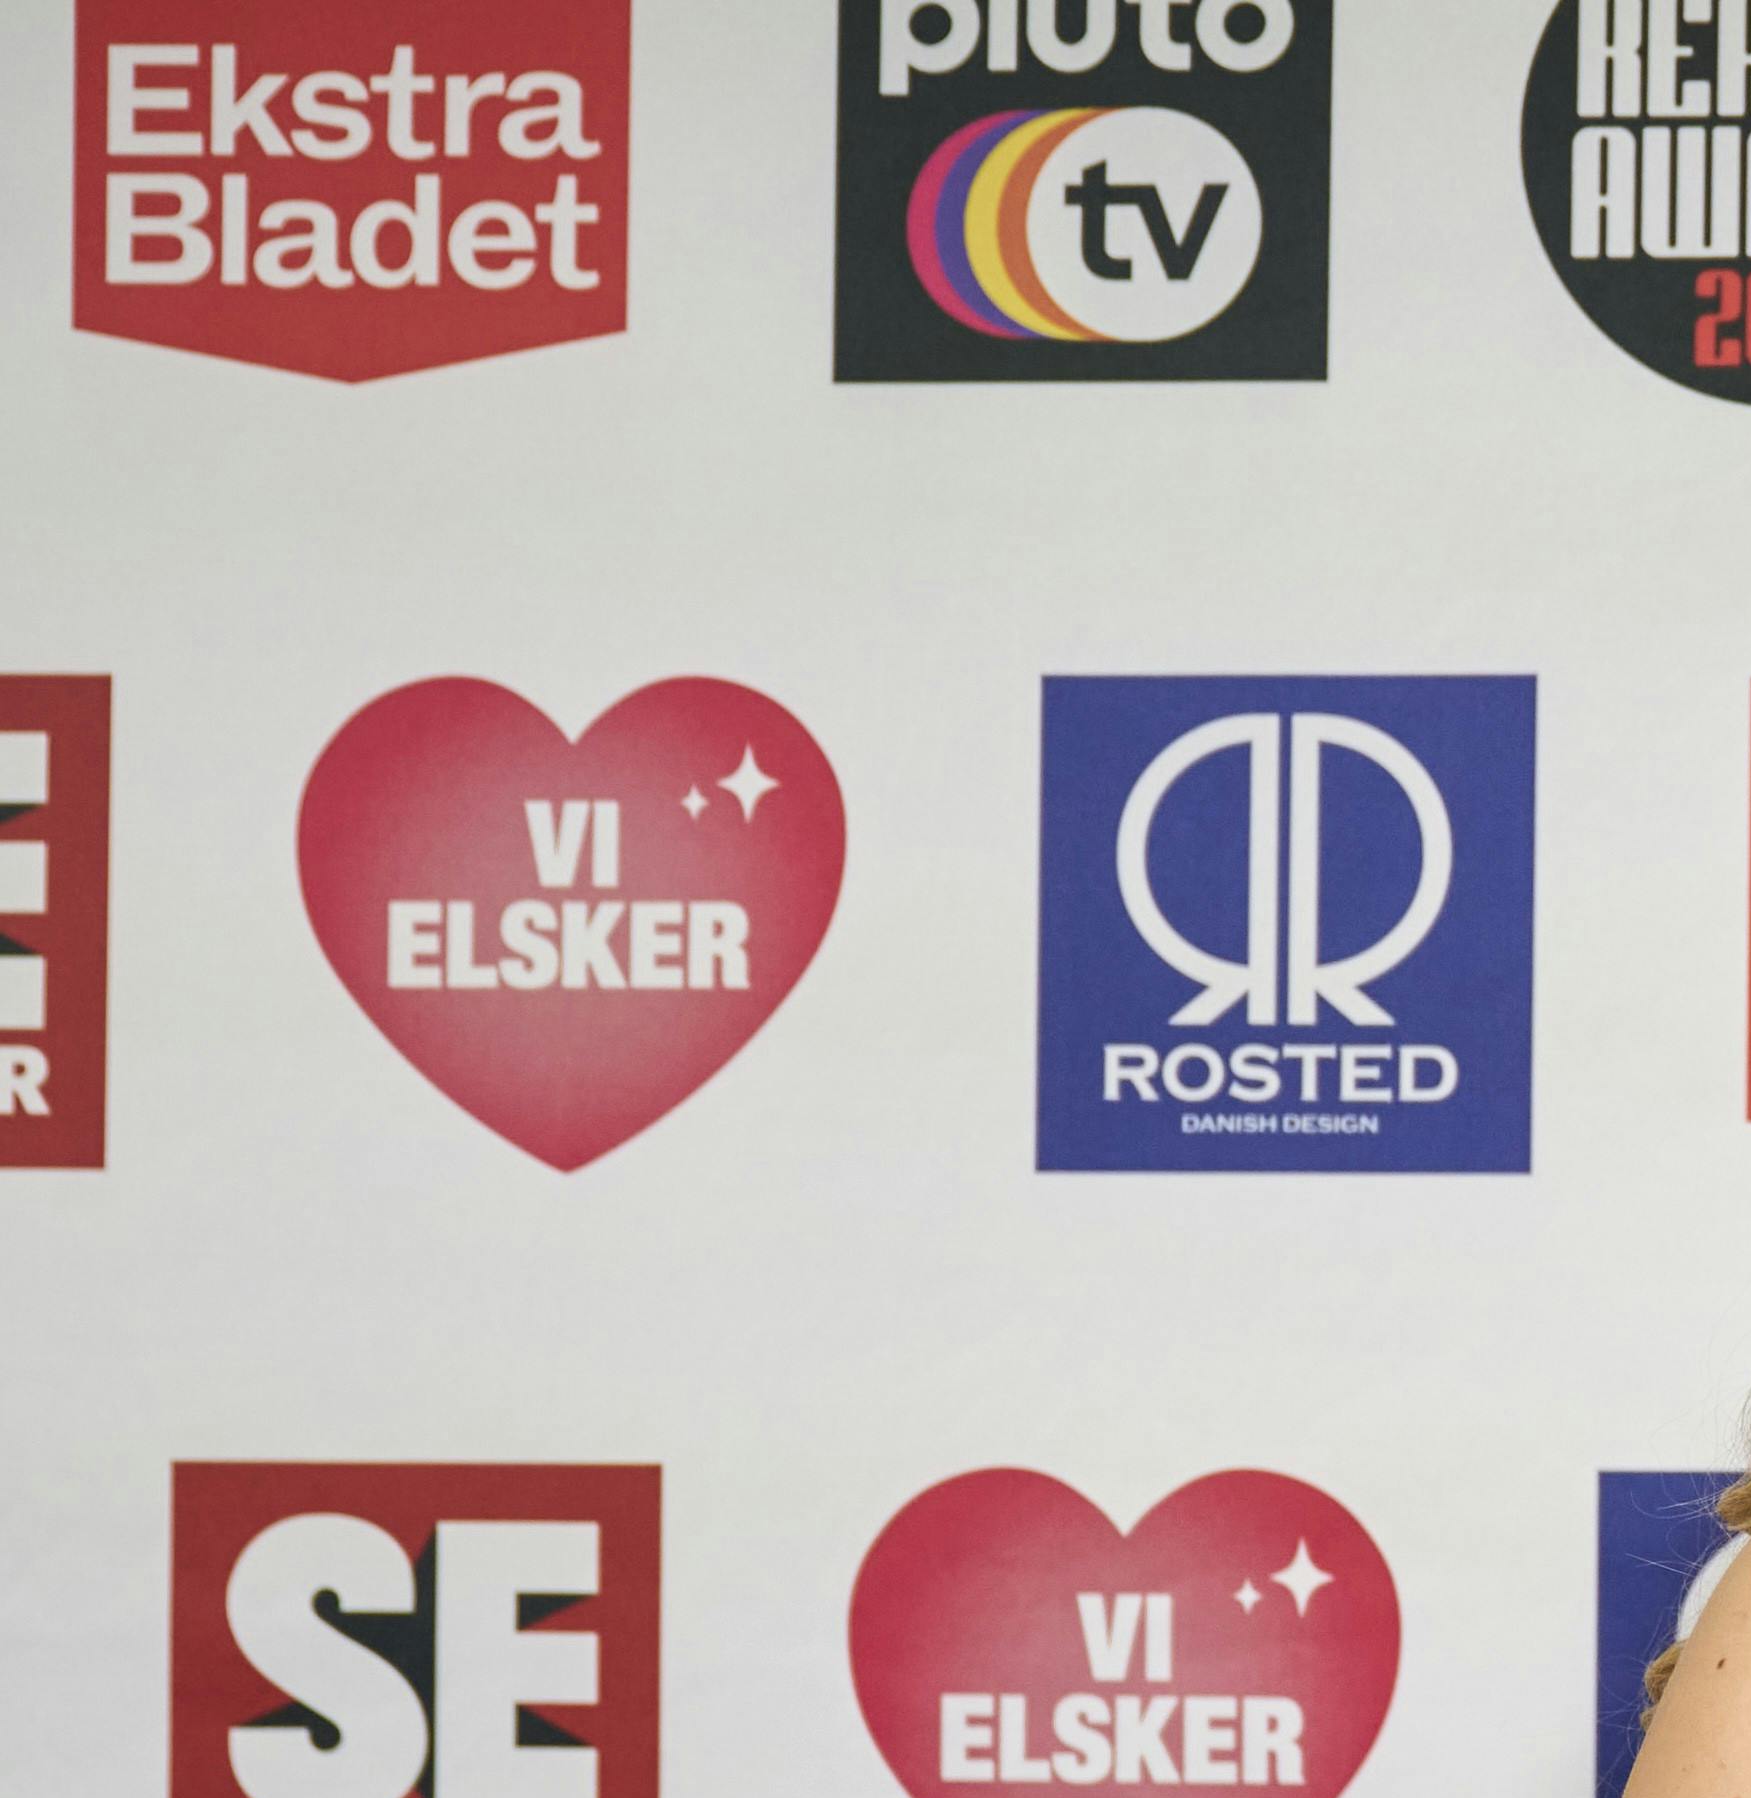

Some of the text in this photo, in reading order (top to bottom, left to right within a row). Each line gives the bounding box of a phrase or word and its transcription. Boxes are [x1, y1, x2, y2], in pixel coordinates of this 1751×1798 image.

[879, 0, 1295, 97] pluto
[105, 43, 602, 162] Ekstra
[103, 172, 600, 292] Bladet
[1064, 158, 1230, 283] tv
[524, 800, 620, 889] VI
[388, 899, 750, 990] ELSKER
[1102, 1043, 1457, 1104] ROSTED
[1181, 1112, 1380, 1135] DANISH DESIGN
[1077, 1595, 1173, 1682] VI
[939, 1693, 1306, 1786] ELSKER
